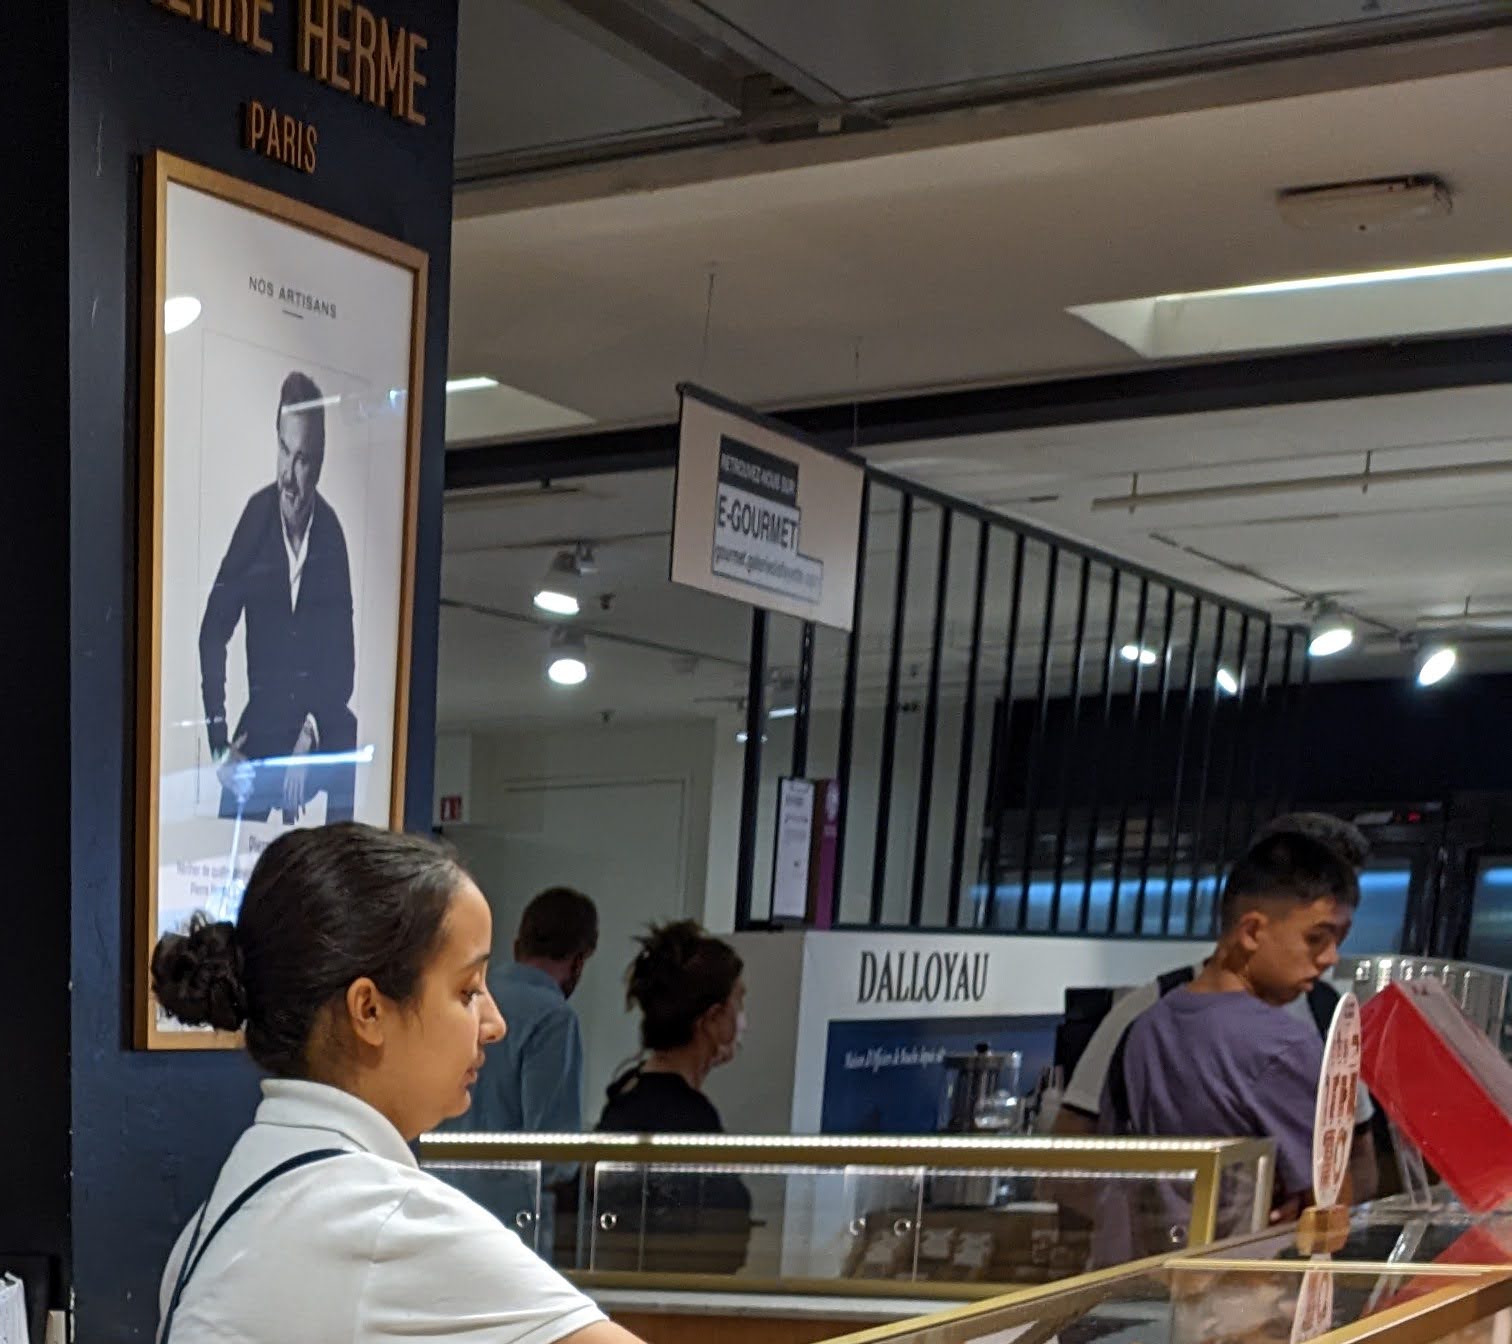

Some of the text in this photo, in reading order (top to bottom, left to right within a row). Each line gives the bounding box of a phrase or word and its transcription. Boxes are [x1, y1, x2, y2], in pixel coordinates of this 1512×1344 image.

[248, 101, 318, 175] PARIS
[249, 276, 338, 320] NOS ARTISANS
[718, 495, 798, 551] E-GOURMET
[857, 950, 989, 1003] DALLOYAU
